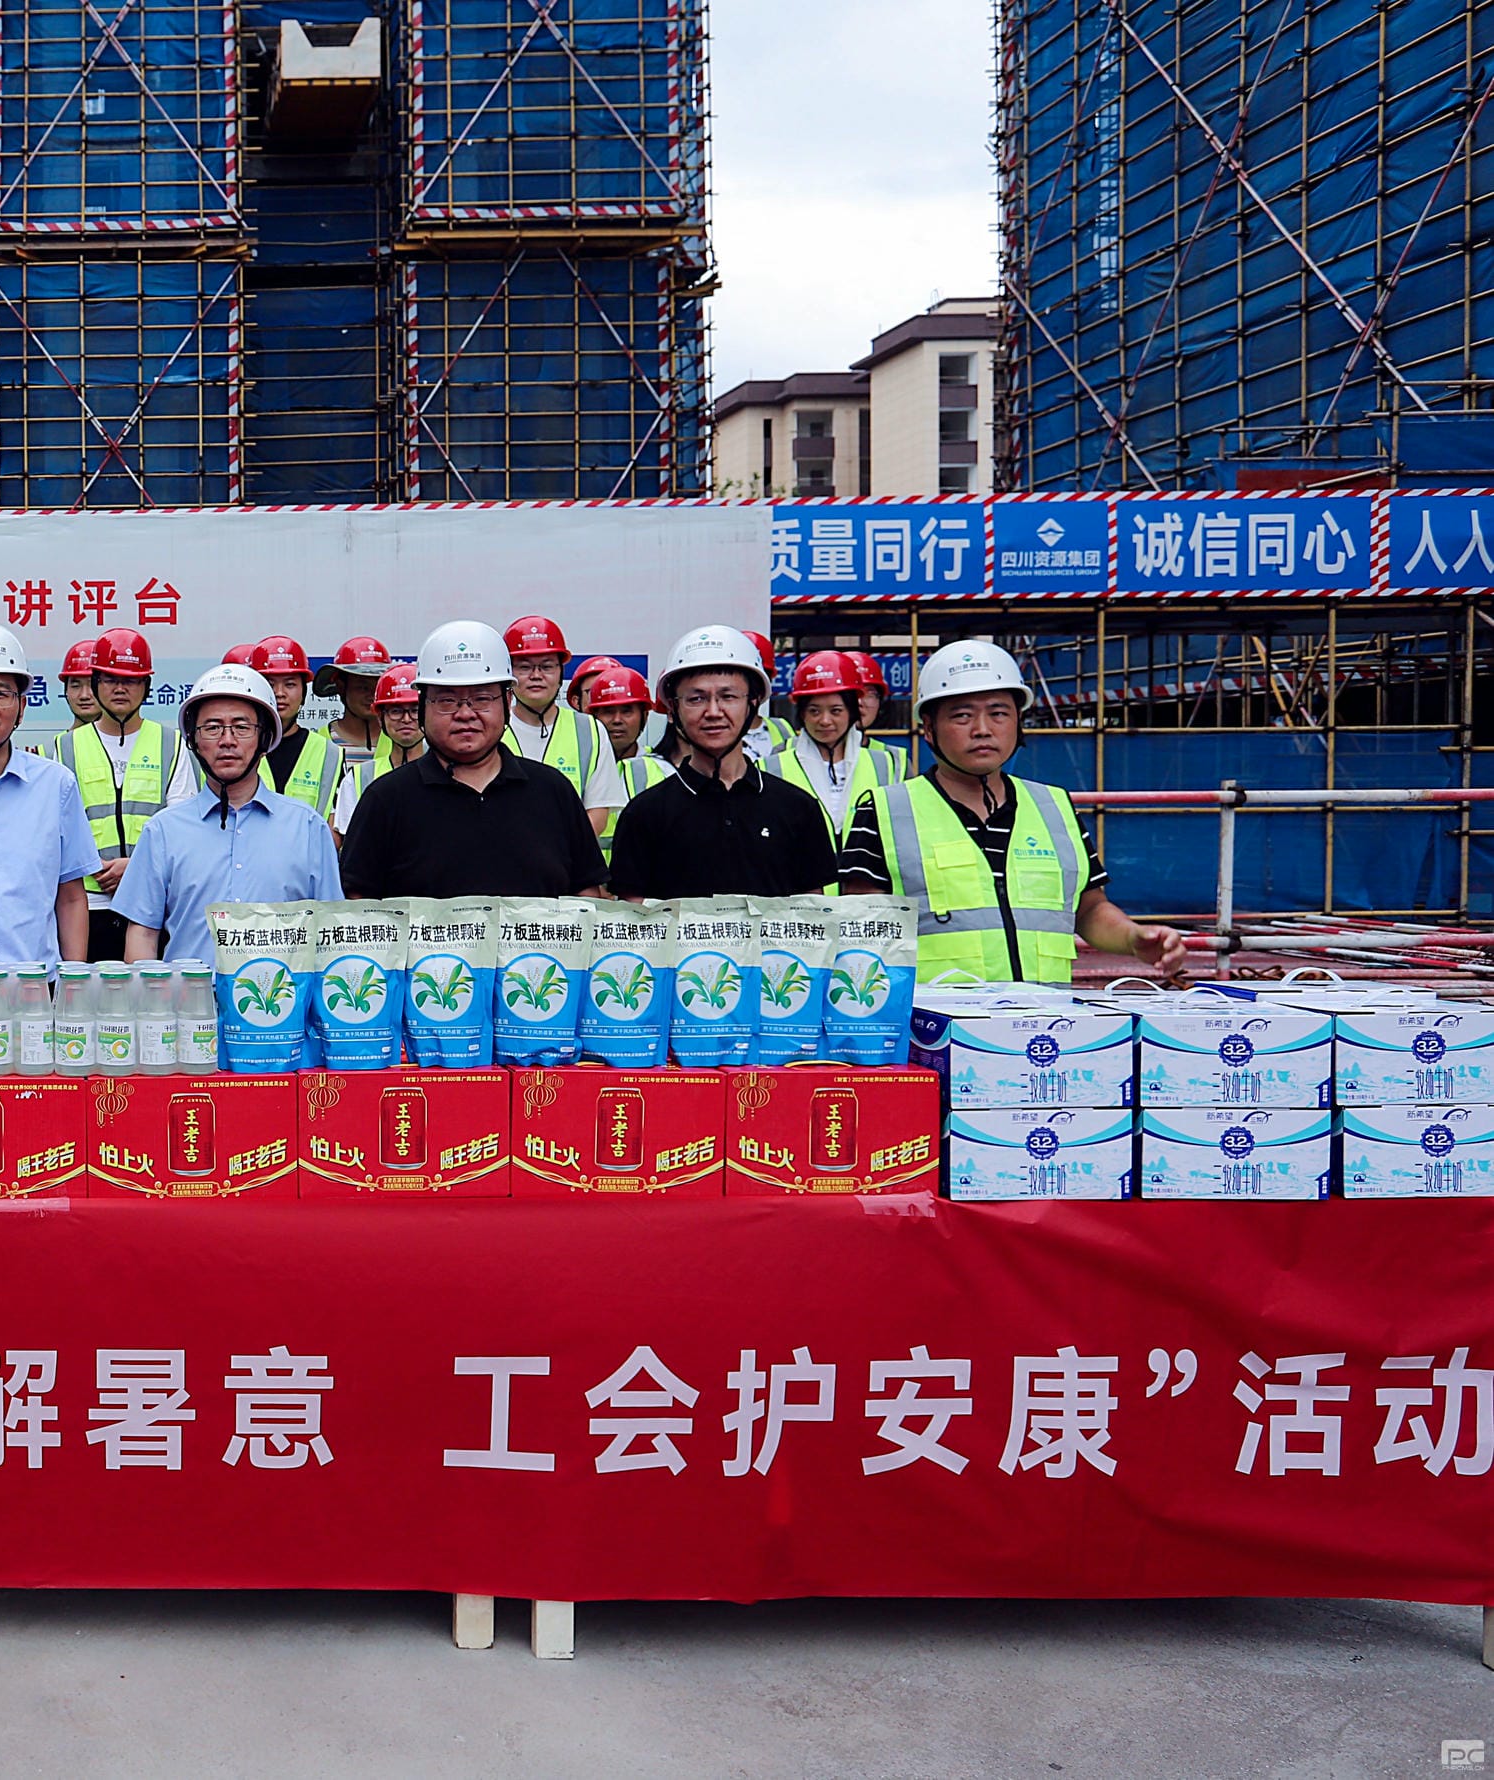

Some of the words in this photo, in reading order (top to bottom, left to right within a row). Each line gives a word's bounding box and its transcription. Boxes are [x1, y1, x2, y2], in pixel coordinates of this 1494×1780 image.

[771, 517, 970, 582] 质量同行
[1001, 550, 1101, 568] 四川资源集团
[1132, 509, 1357, 578] 诚信同心
[1404, 508, 1494, 575] 人人
[444, 652, 482, 660] 四川资源集团
[948, 662, 990, 674] 四川资源集团
[217, 927, 308, 946] 复方板蓝根颗粒
[317, 924, 398, 945] 方板蓝根颗粒
[183, 1110, 199, 1162] 王老吉
[395, 1104, 411, 1156] 王老吉
[611, 1104, 628, 1157] 王老吉
[825, 1105, 842, 1157] 王老吉
[17, 1142, 75, 1178] 喝王老吉
[99, 1143, 154, 1177] 怕上火
[228, 1139, 287, 1176] 喝王老吉
[310, 1136, 365, 1171] 怕上火
[440, 1133, 499, 1170] 喝王老吉
[525, 1134, 580, 1171] 怕上火
[656, 1136, 715, 1172] 喝王老吉
[739, 1136, 795, 1172] 怕上火
[871, 1135, 930, 1172] 喝王老吉
[444, 1345, 1494, 1478] 工会护安康”活动
